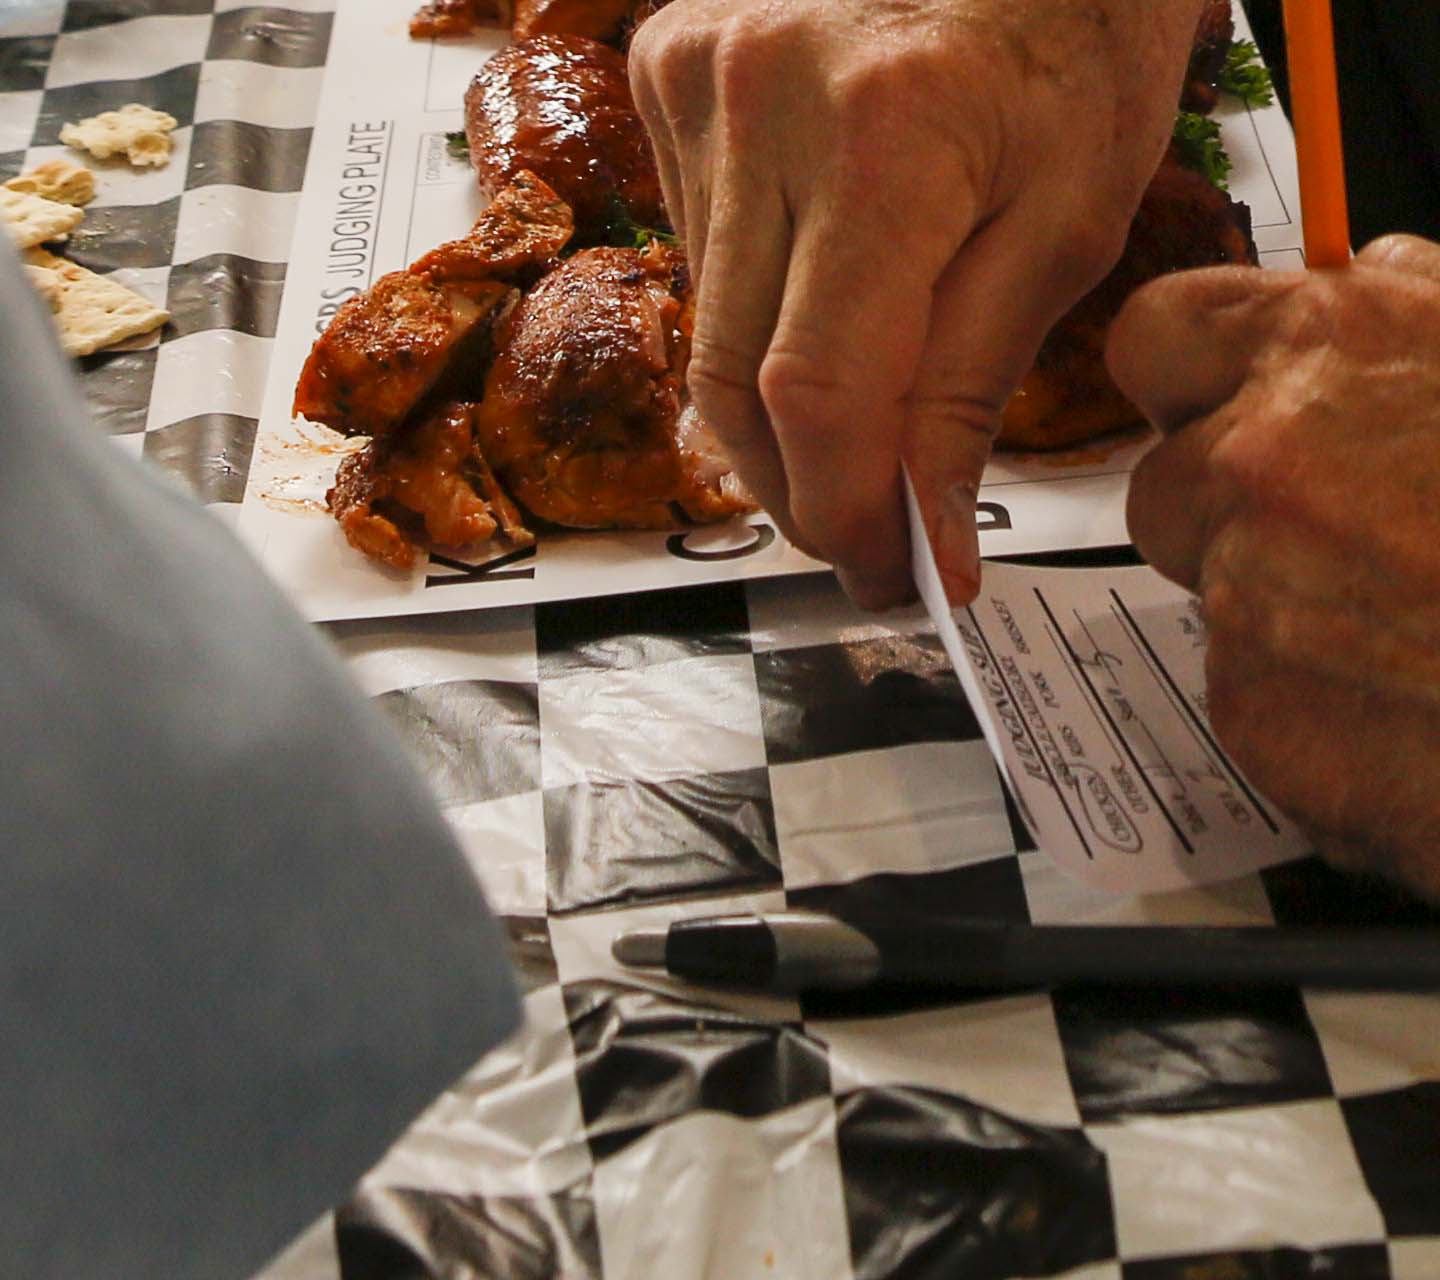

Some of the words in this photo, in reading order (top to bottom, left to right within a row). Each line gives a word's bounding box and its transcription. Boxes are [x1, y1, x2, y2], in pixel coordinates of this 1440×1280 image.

[342, 120, 387, 182] PLATE
[326, 183, 376, 278] JUDGING
[990, 597, 1032, 656] BRISKET
[1031, 670, 1060, 709] PORK
[988, 676, 1052, 786] JUDGING
[1086, 774, 1131, 842] CHICKEN
